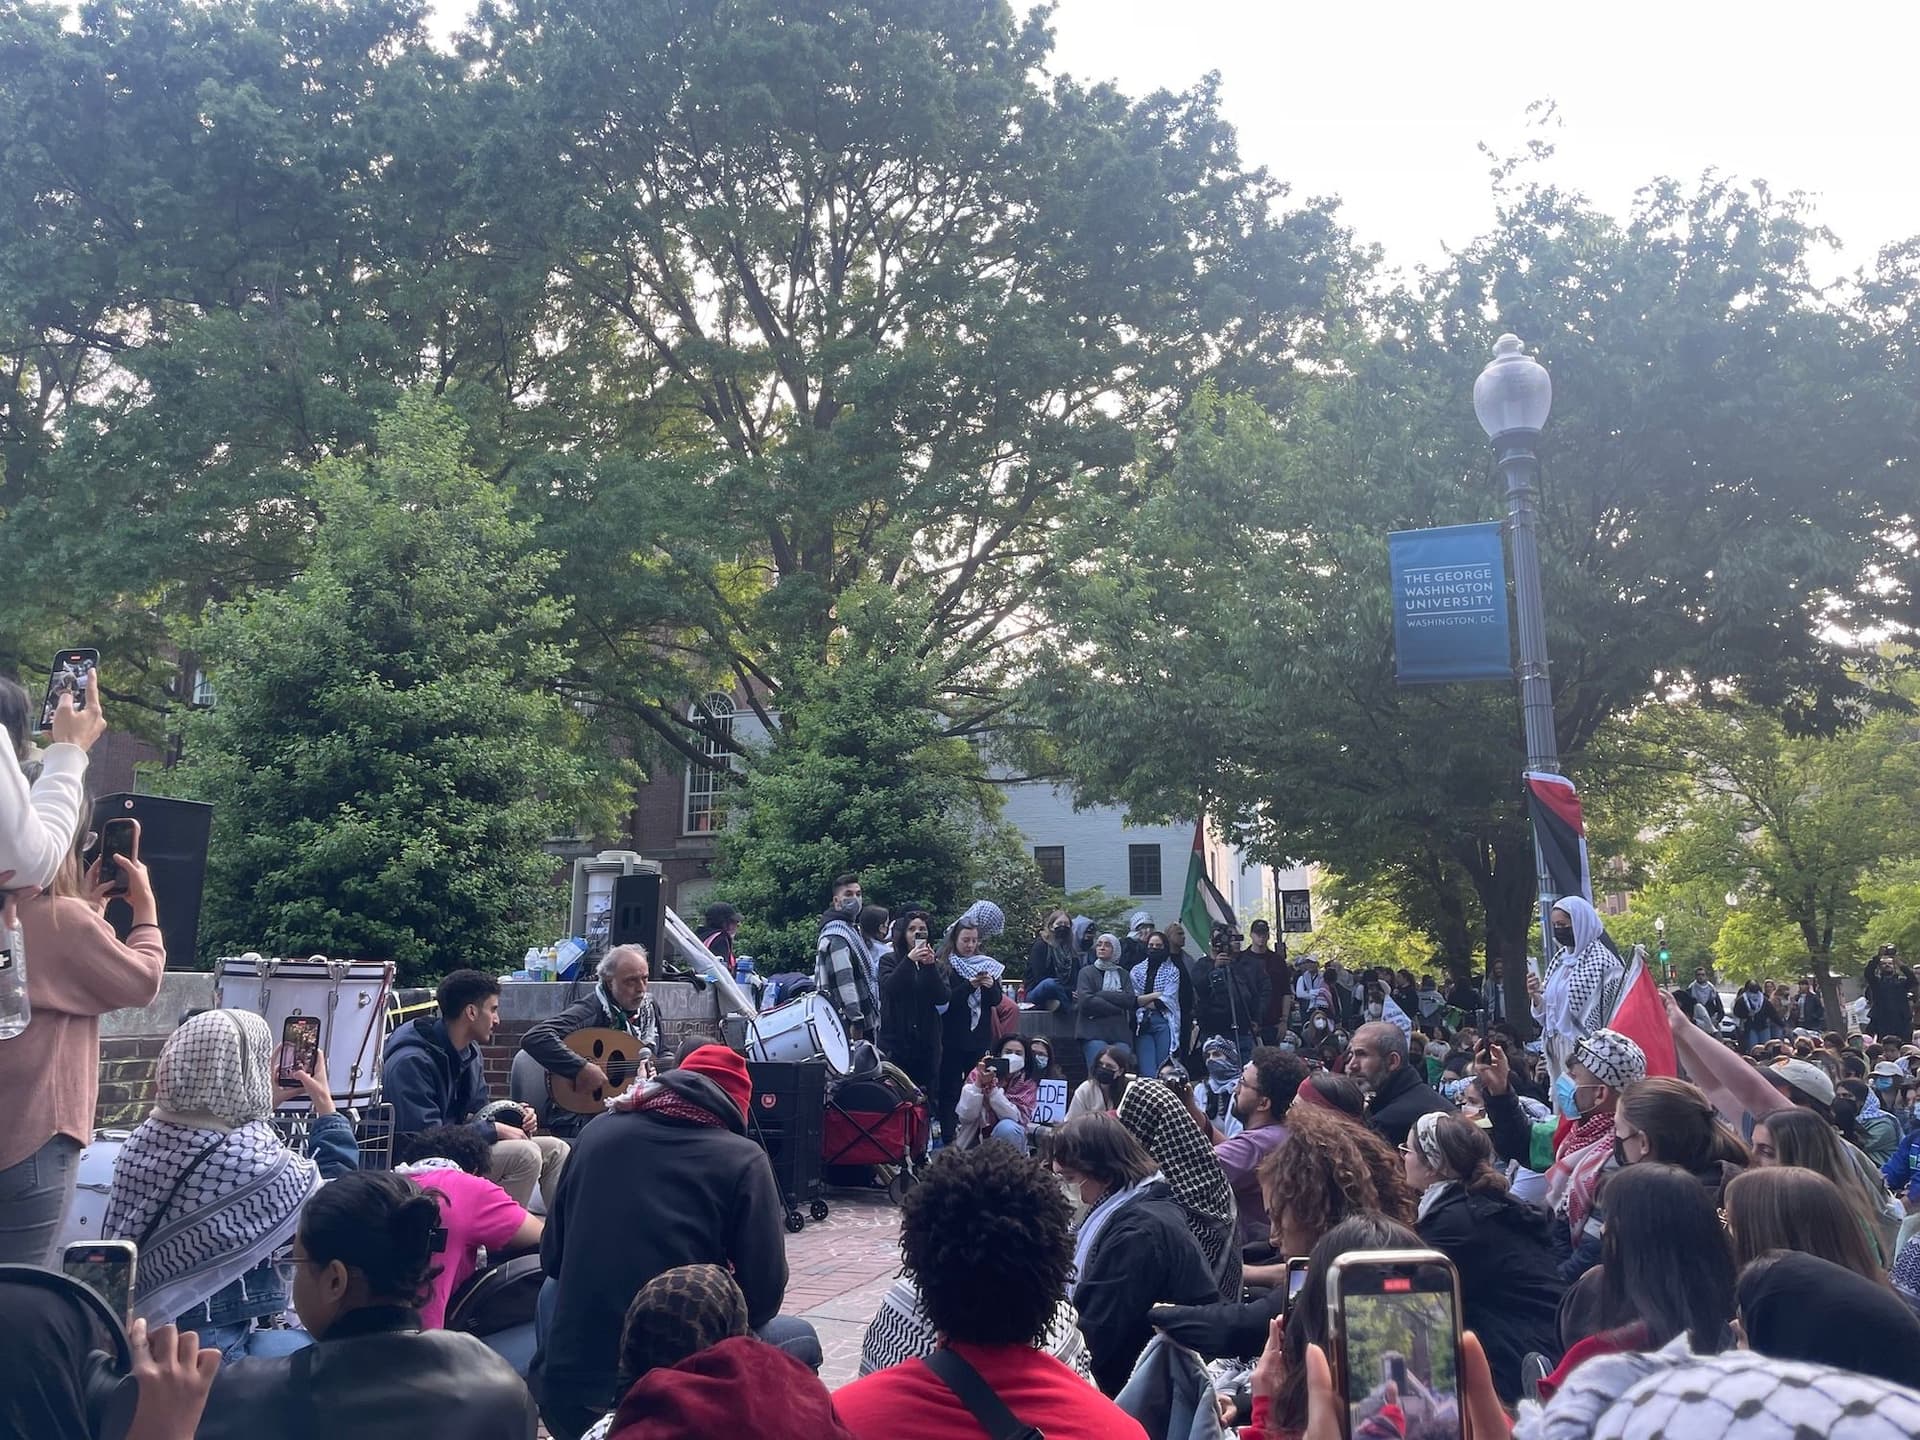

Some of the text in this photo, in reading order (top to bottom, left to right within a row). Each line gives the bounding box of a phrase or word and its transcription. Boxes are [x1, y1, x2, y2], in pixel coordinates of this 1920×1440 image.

[1404, 569, 1492, 585] THE GEORGE
[1405, 582, 1494, 597] WASHINGTON
[1405, 595, 1494, 610] UNIVERSITY
[1407, 615, 1496, 628] WASHINGTON, DC
[1285, 904, 1309, 919] REVS
